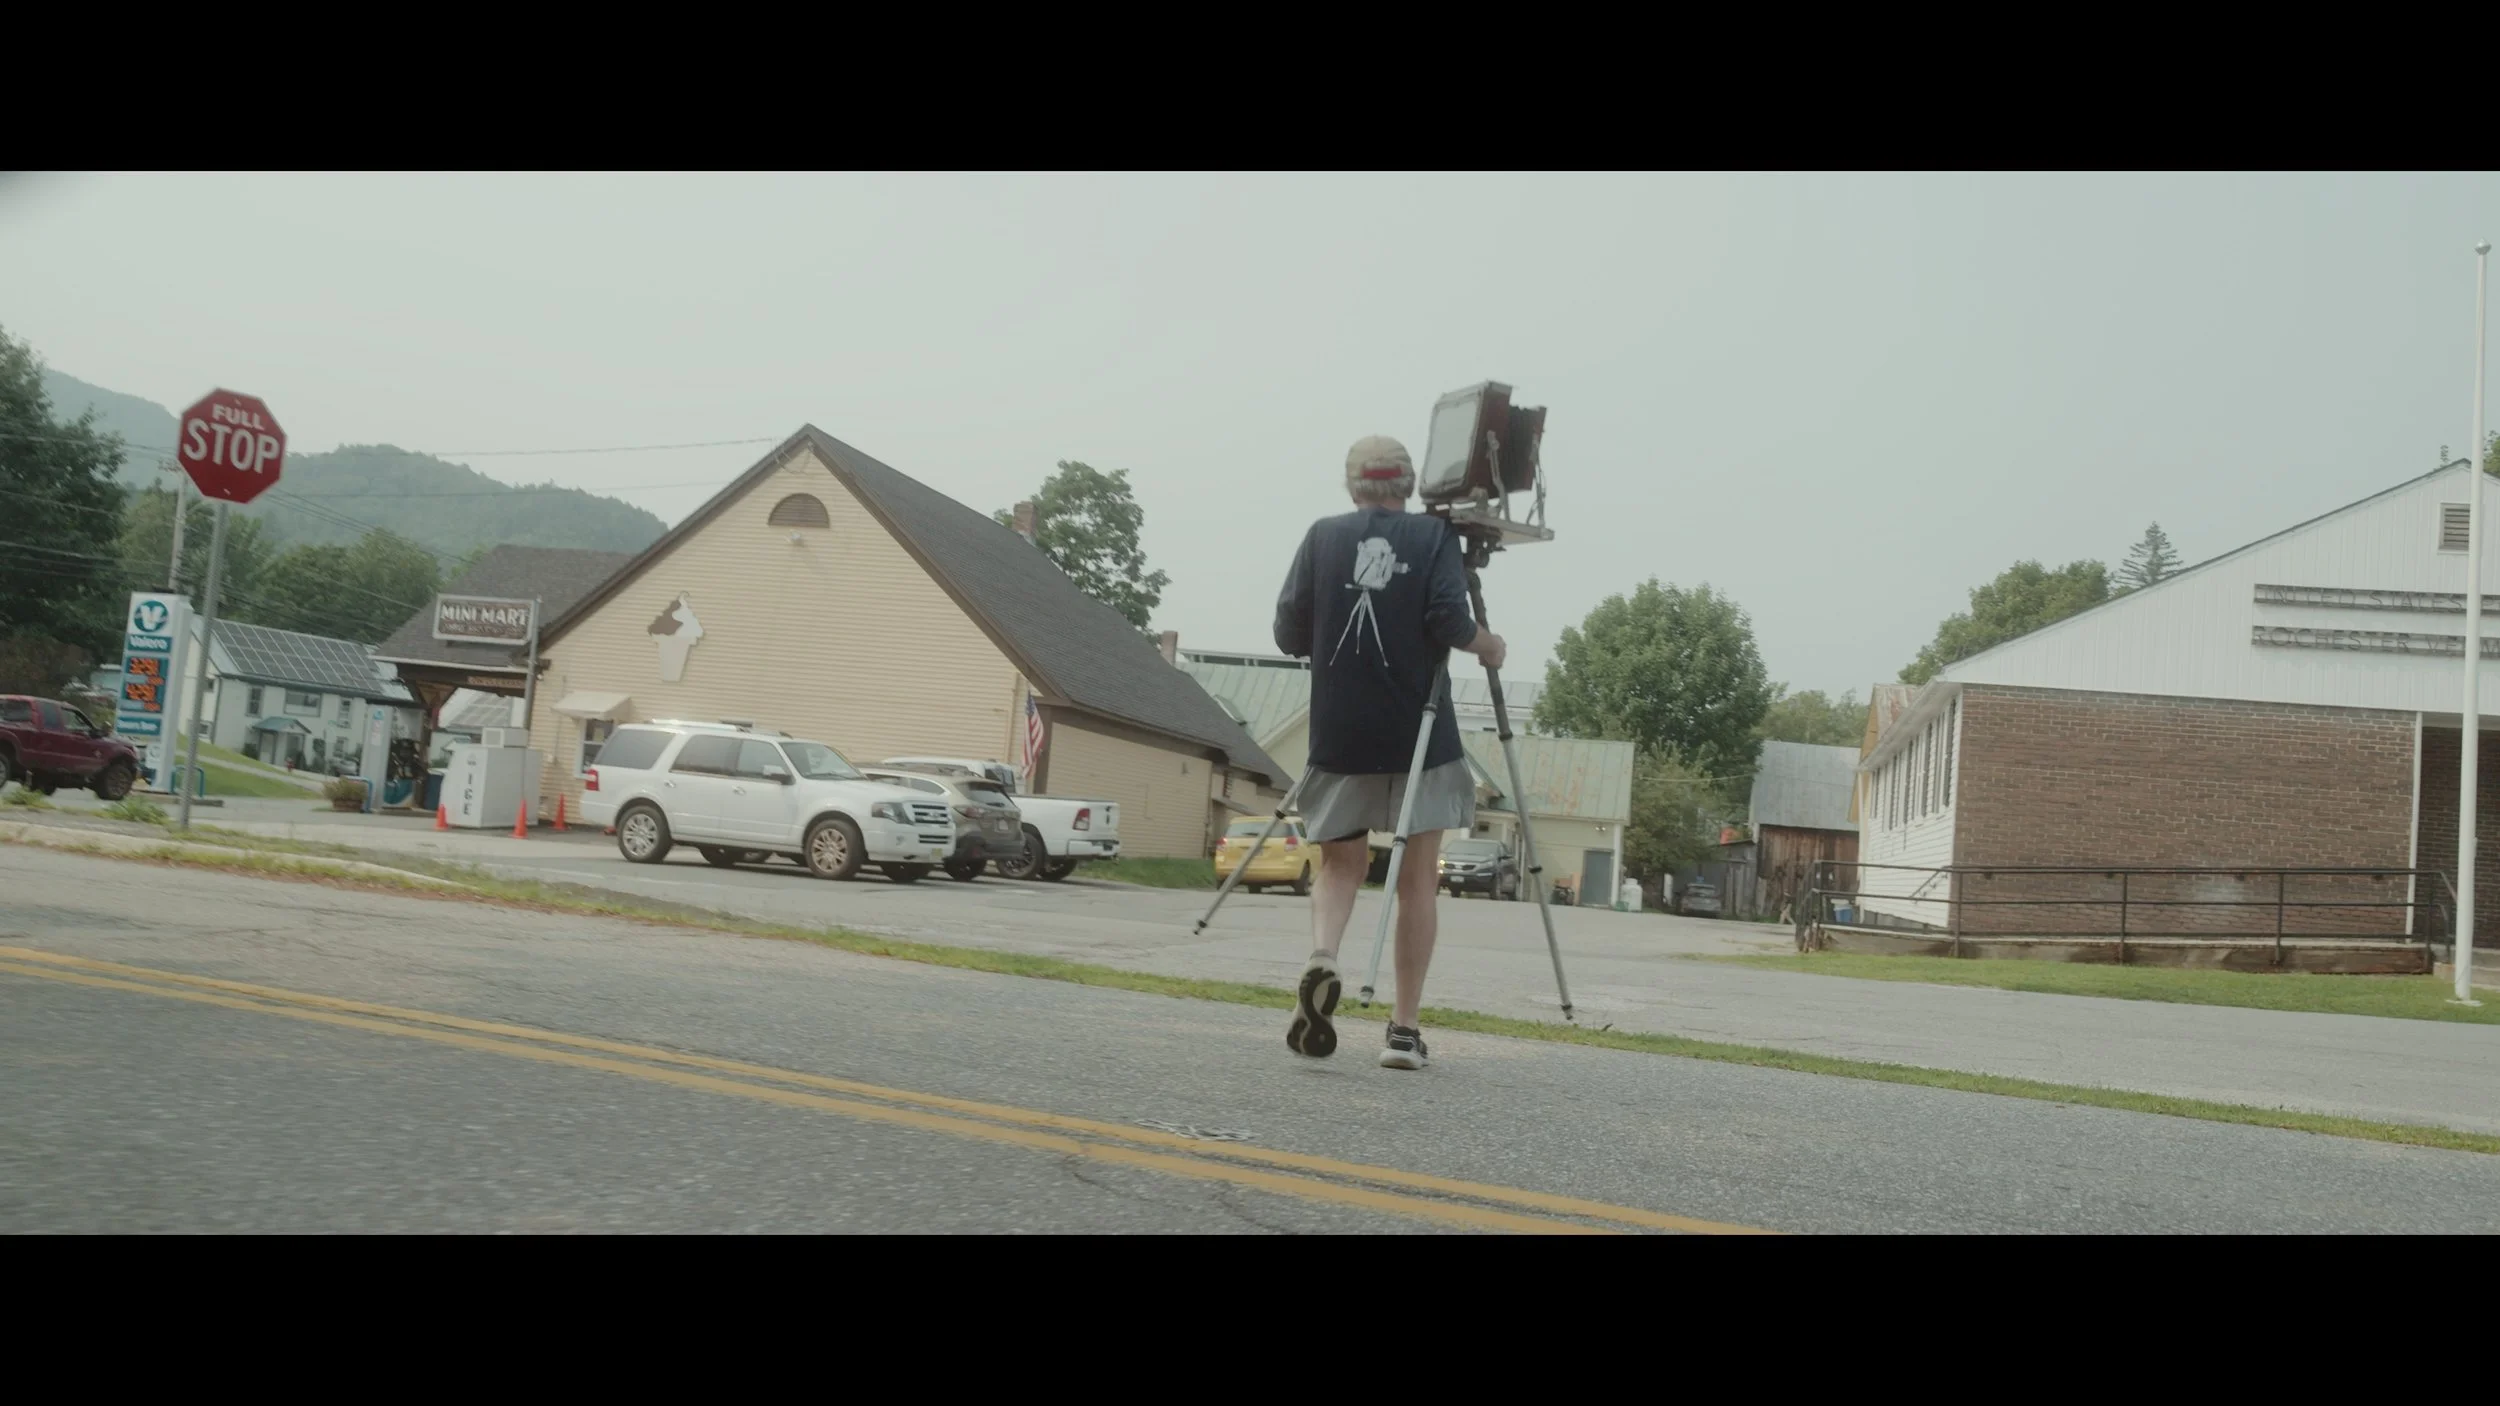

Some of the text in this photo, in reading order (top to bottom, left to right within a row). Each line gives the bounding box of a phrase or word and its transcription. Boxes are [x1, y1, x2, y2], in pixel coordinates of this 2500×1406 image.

[212, 403, 265, 431] FULL
[183, 418, 280, 474] STOP
[2254, 585, 2356, 609] UNITED
[2369, 590, 2463, 613] STATES
[441, 604, 528, 627] MINI MART
[2252, 626, 2410, 652] ROCHESTER
